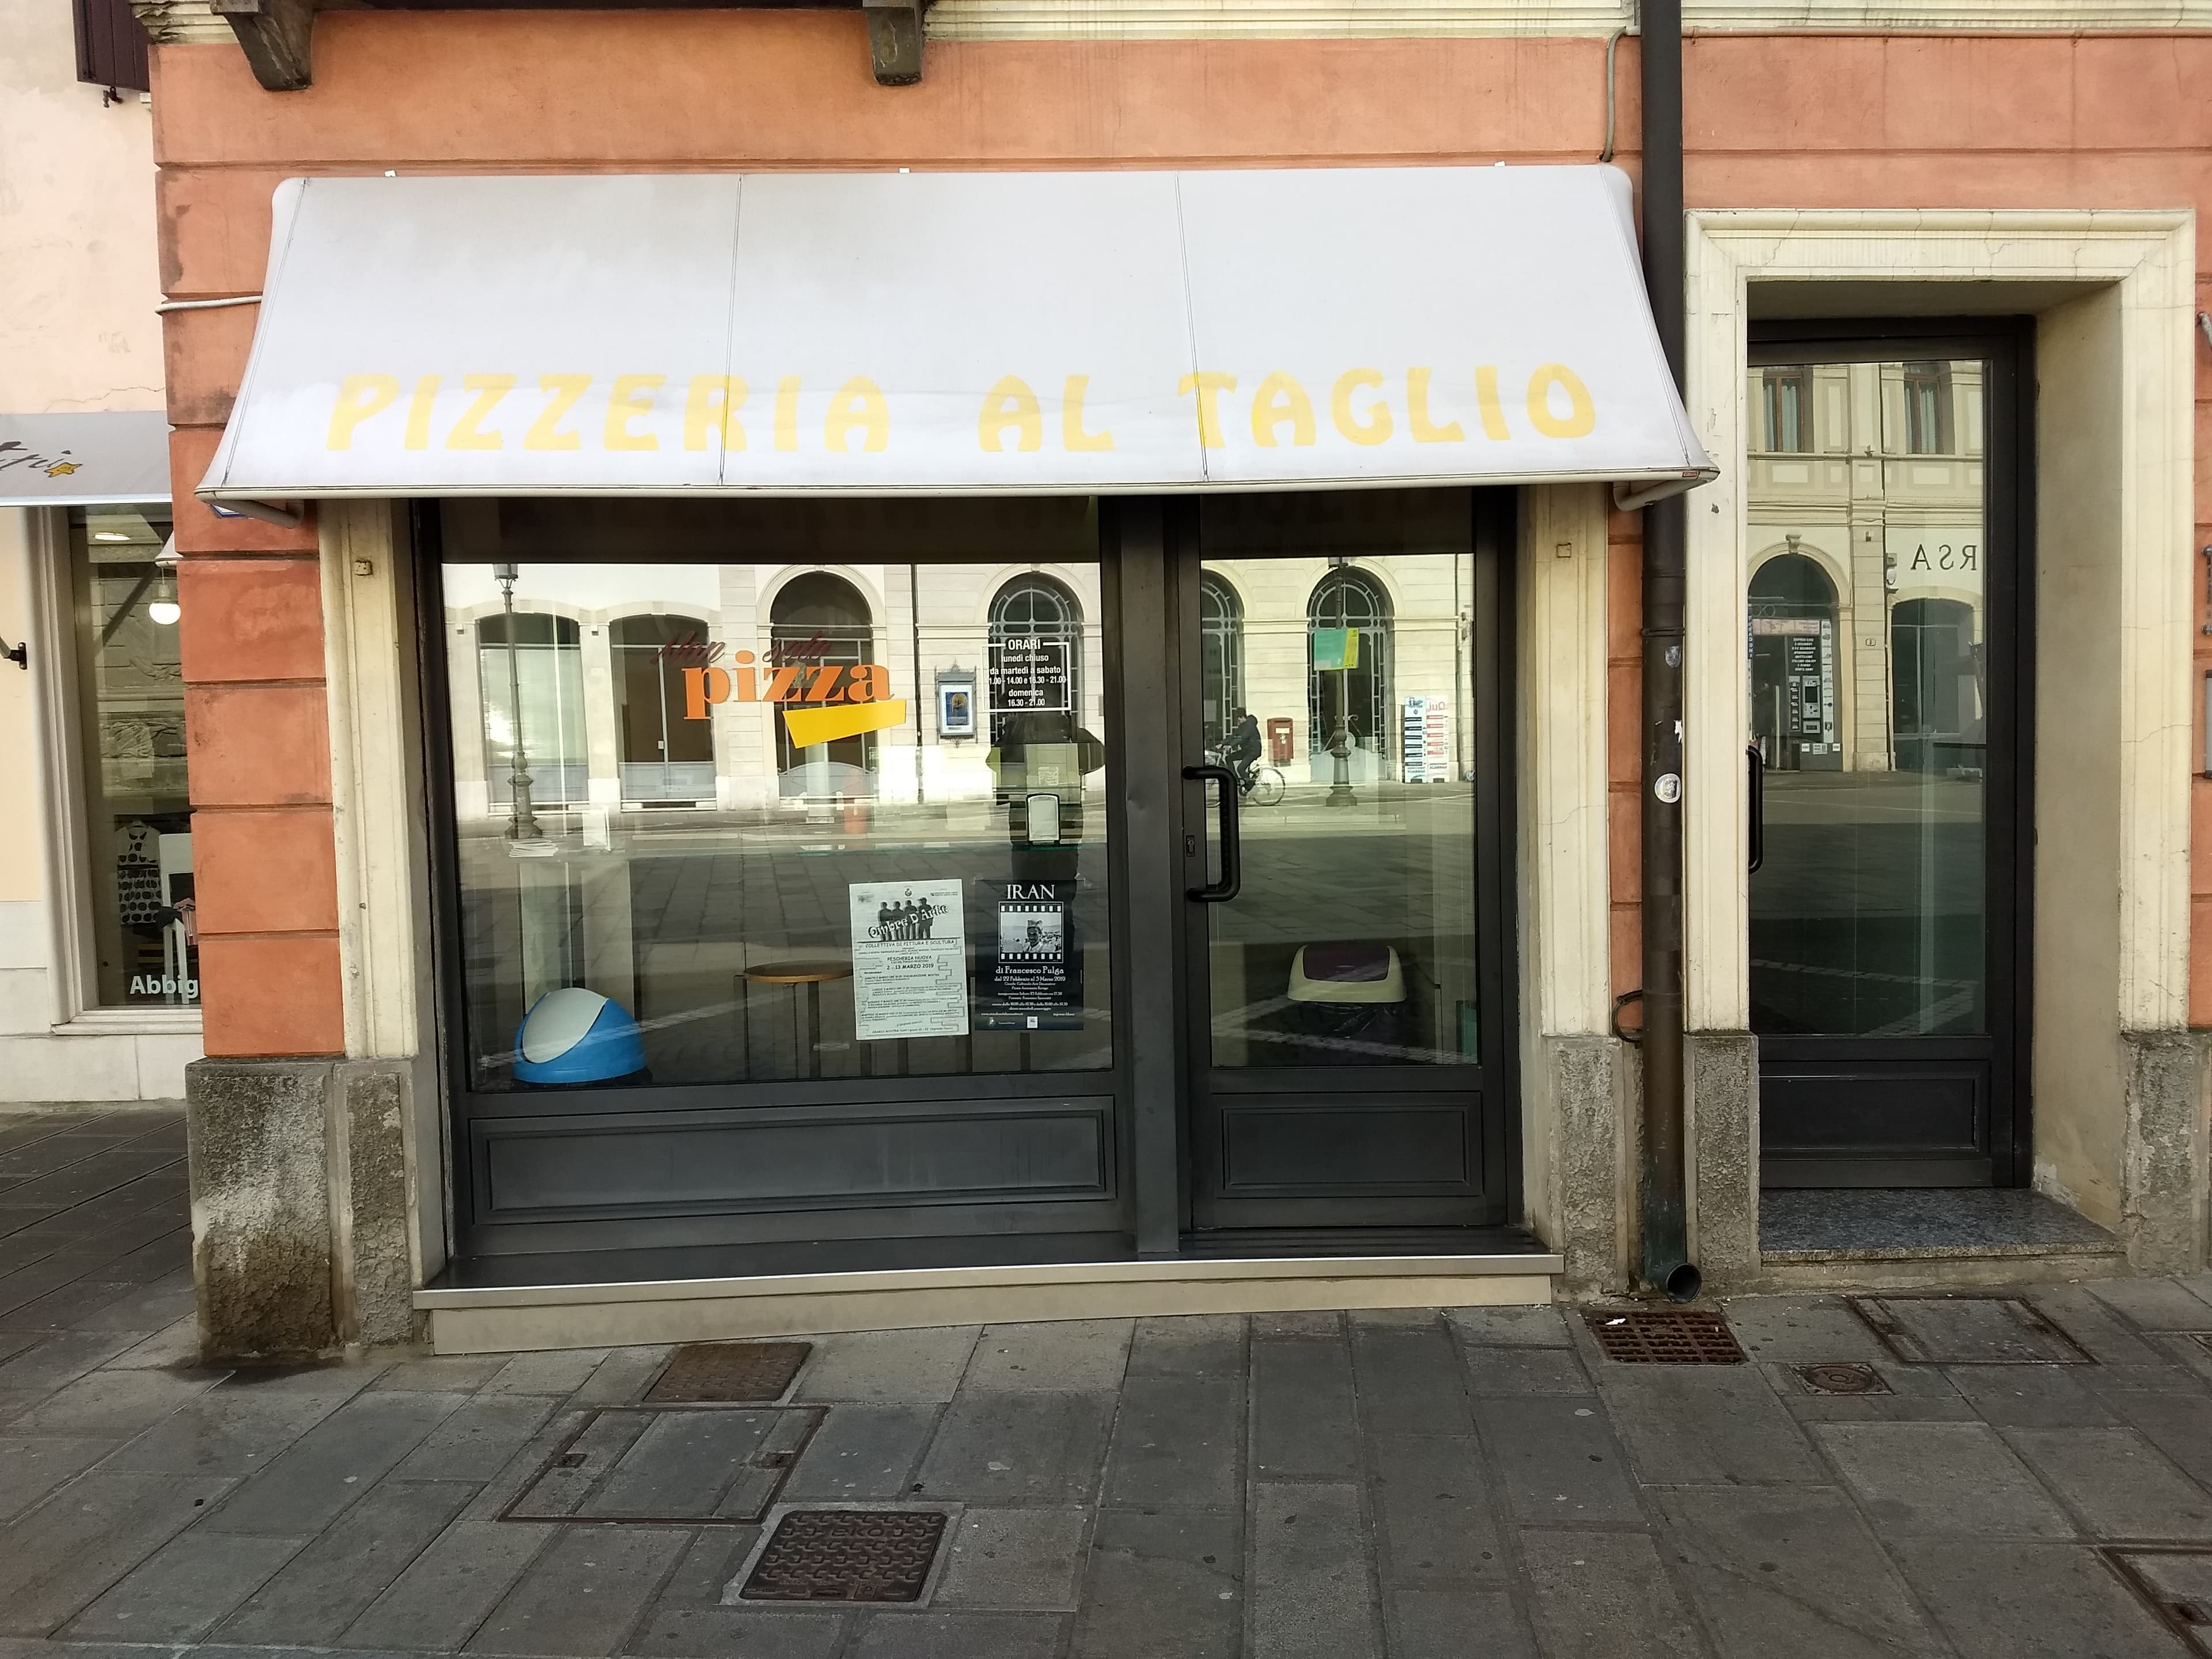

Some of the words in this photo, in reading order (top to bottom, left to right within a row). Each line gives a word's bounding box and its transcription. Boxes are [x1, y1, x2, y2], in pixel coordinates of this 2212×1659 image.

[327, 372, 890, 452] PIZZERIA
[978, 374, 1116, 452] AL
[1177, 362, 1596, 449] TAGLIO
[1007, 638, 1041, 650] ORARI
[1001, 654, 1024, 662] lunedì
[1025, 654, 1049, 662] chiuso
[1001, 666, 1029, 675] martedì
[1036, 665, 1061, 673] sabato
[681, 650, 895, 719] pizza
[1006, 676, 1022, 684] 14.00
[1029, 676, 1045, 684] 16.30
[1050, 675, 1066, 684] 21.00
[1008, 688, 1044, 697] domenica
[1007, 699, 1024, 707] 16.30
[1029, 698, 1046, 706] 21.00
[1006, 884, 1055, 899] IRAN
[868, 918, 908, 938] Ombre
[1042, 966, 1064, 975] Pulga
[130, 975, 198, 999] Abbig
